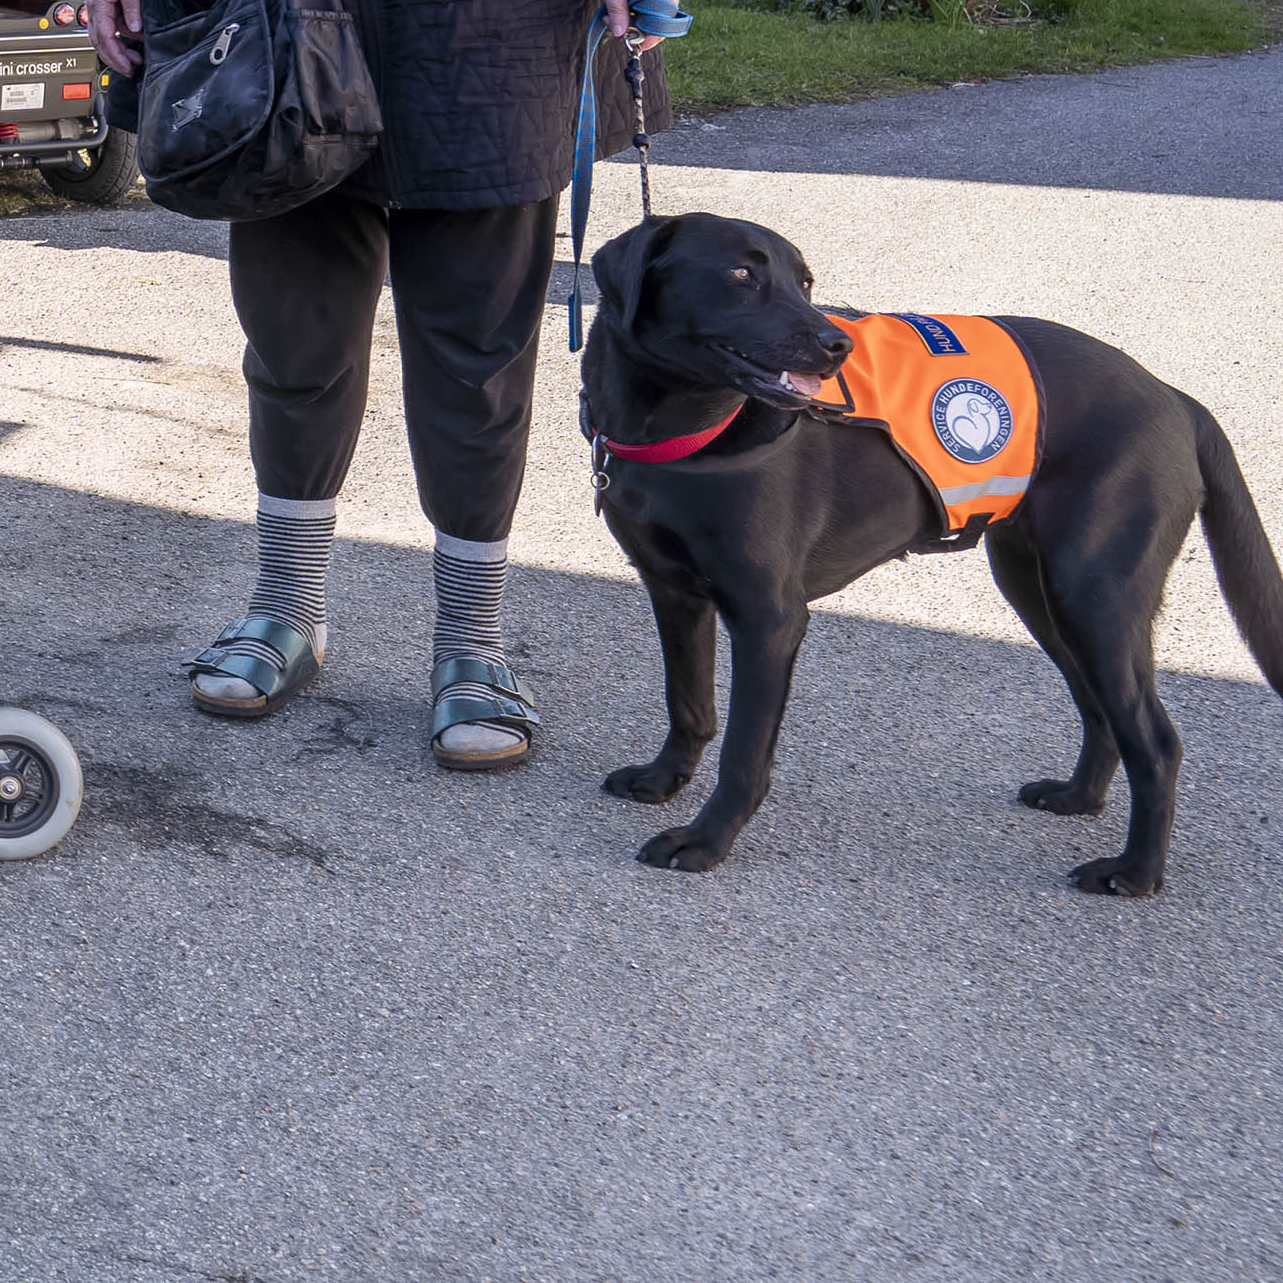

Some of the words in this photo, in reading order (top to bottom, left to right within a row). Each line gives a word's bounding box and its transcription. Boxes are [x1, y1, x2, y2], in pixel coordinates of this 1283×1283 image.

[16, 62, 63, 75] crosser
[66, 58, 77, 67] X1
[925, 324, 956, 352] HUND
[936, 405, 962, 453] SERVICE
[938, 383, 1011, 451] HUNDEFORENINGEN
